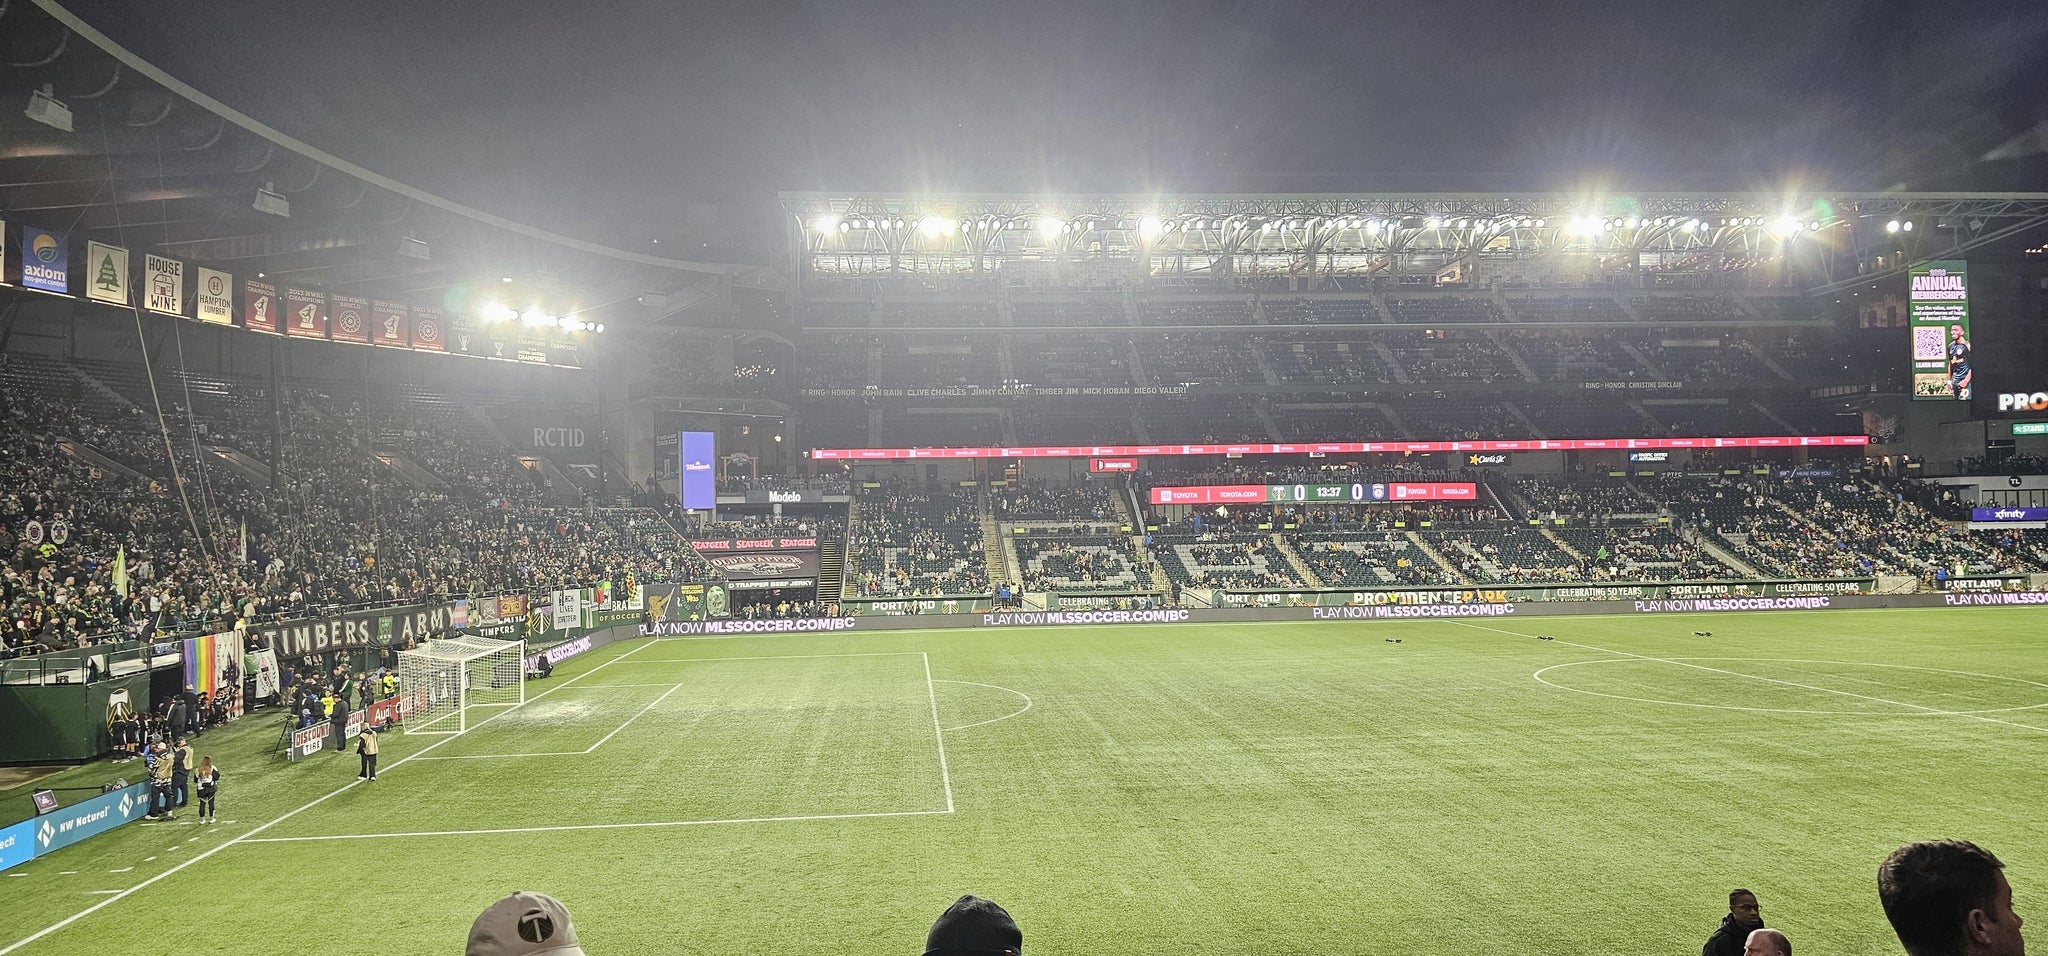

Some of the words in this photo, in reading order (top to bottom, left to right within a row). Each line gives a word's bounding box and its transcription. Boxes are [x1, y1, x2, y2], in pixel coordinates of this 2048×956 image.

[149, 256, 180, 277] HOUSE
[24, 264, 66, 281] axiom
[24, 276, 47, 284] eco-pest
[47, 279, 66, 288] control
[1912, 276, 1966, 290] ANNUAL
[248, 286, 276, 297] CHAMPIONS
[1912, 290, 1967, 300] MEMBERSHIPS
[150, 294, 177, 311] WINE
[199, 294, 231, 309] HAMPTON
[289, 294, 325, 304] CHAMPIONS
[204, 304, 226, 316] LUMBER
[340, 302, 361, 310] SHIELD
[375, 306, 407, 316] CHAMPIONS
[1134, 386, 1157, 395] DIEGO
[1158, 386, 1187, 394] VALERI
[1628, 381, 1657, 389] CHRISTINE
[1657, 381, 1683, 389] SINCLAIR
[831, 388, 856, 396] HONOR
[860, 388, 882, 396] JOHN
[907, 388, 930, 396] CLIVE
[930, 388, 967, 396] CHARLES
[971, 388, 996, 396] JIMMY
[997, 387, 1030, 396] CONWAY
[1034, 388, 1064, 396] TIMBER
[1082, 387, 1101, 395] MICK
[1103, 387, 1130, 395] HOBAN
[533, 427, 585, 447] RCTID
[768, 490, 801, 502] Modelo
[1294, 484, 1305, 501] 0
[1316, 486, 1342, 497] 13:37
[1351, 483, 1363, 500] 0
[1994, 509, 2026, 520] xfinity
[691, 540, 730, 550] SEATGEEK
[736, 540, 774, 549] SEATGEEK
[780, 538, 817, 548] SEATGEEK
[789, 579, 813, 587] JERKY
[1775, 583, 1824, 592] CELERATING
[1824, 583, 1835, 591] 50
[1835, 582, 1860, 591] YEARS
[1945, 579, 2002, 589] PORTLAND
[1607, 587, 1618, 596] 50
[1619, 586, 1642, 596] YEARS
[1058, 597, 1109, 606] CELEBRATING
[1634, 601, 1661, 612] PLAY
[1664, 600, 1695, 611] NOW
[1695, 596, 1830, 610] MLSSOCCER.COM/BC
[1945, 594, 1972, 605] PLAY
[1973, 593, 2002, 604] NOW
[1313, 607, 1341, 618] PLAY
[1343, 606, 1374, 617] NOW
[1375, 603, 1515, 617] MLSSOCCER.COM/BC
[611, 612, 641, 621] SOCCER
[983, 614, 1012, 625] PLAY
[1014, 613, 1045, 624] NOW
[1047, 609, 1189, 623] MLSSOCCER.COM/BC
[638, 622, 669, 636] PLAY
[670, 621, 704, 634] NOW
[705, 616, 856, 633] MLSSOCCER.COM/BC
[263, 619, 370, 656] TIMBERS
[374, 704, 391, 722] Audi
[294, 722, 331, 748] DISCOUNT
[346, 726, 360, 739] TIRE
[305, 740, 321, 753] TIRE
[137, 792, 149, 805] NW
[60, 819, 74, 833] NW
[76, 808, 108, 827] Natural
